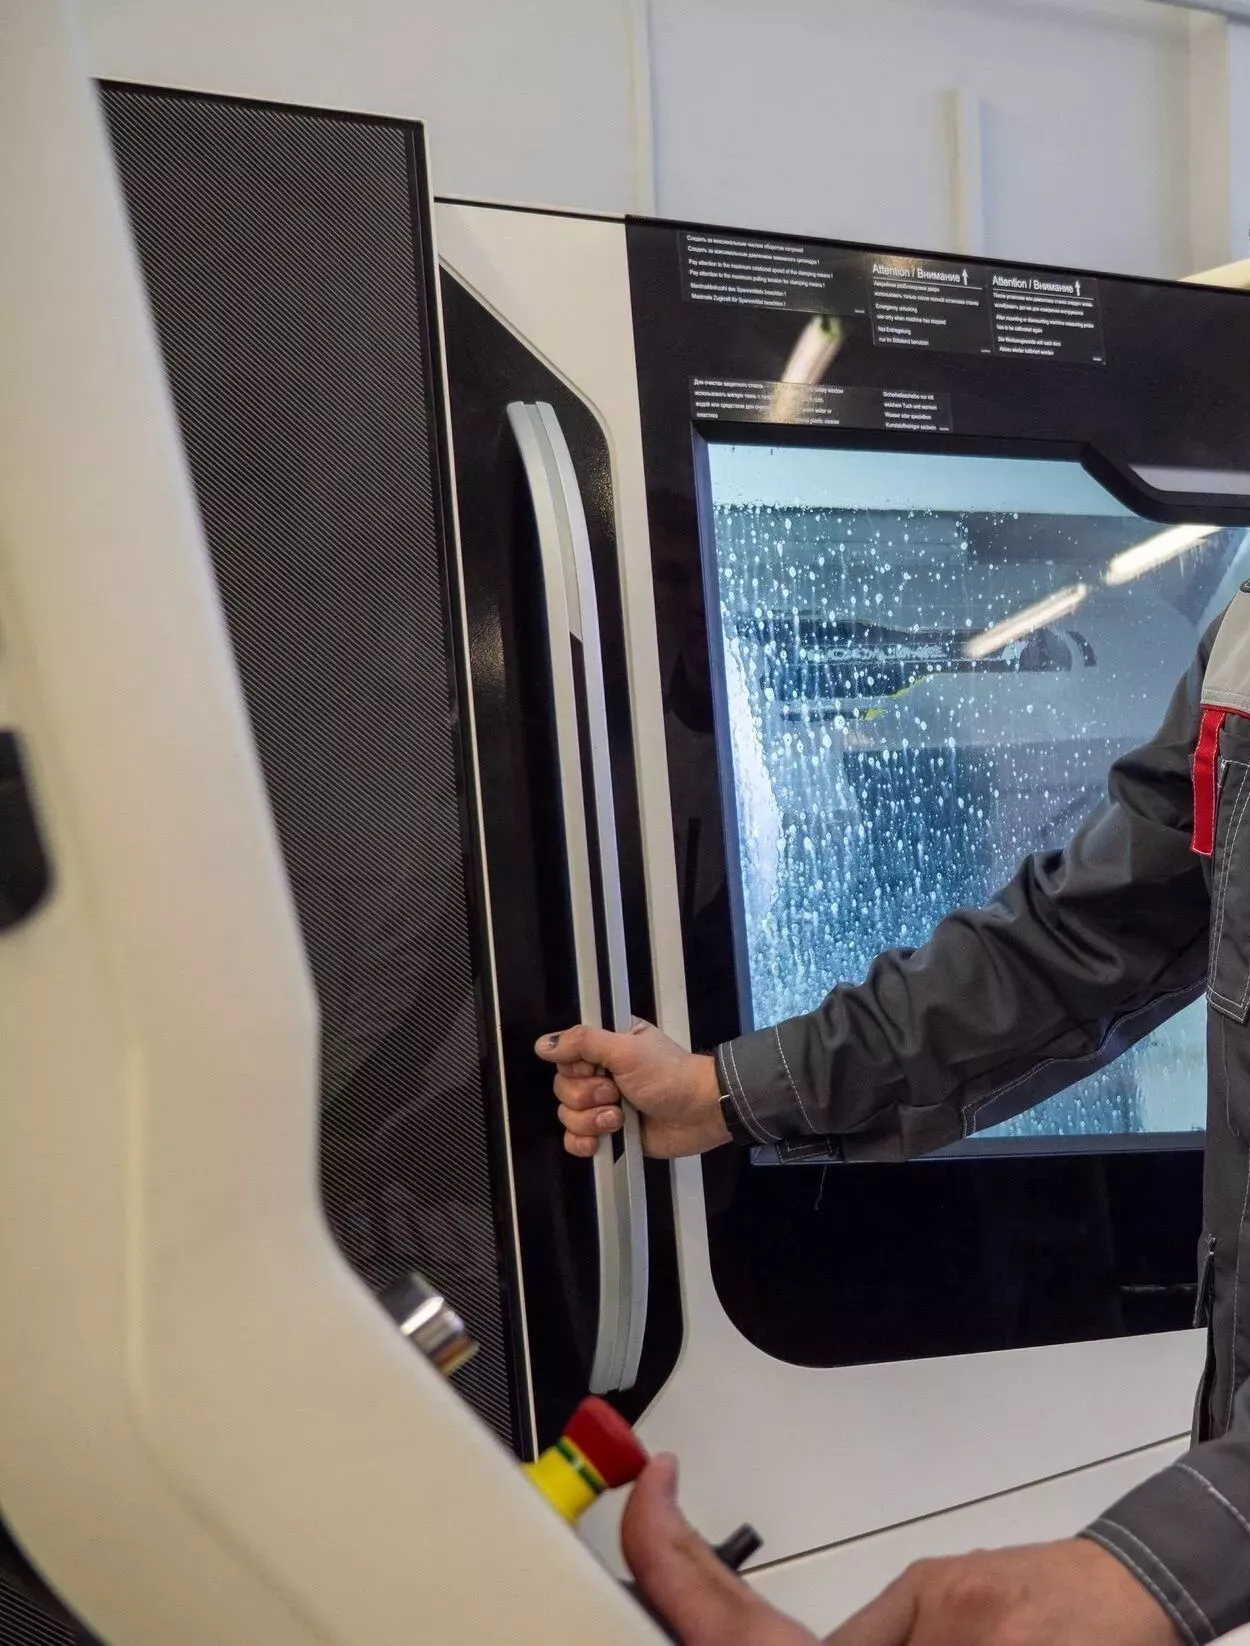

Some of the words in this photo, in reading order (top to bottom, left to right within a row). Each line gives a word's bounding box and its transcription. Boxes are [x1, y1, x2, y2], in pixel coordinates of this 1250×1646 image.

[873, 264, 910, 277] Attention
[917, 268, 960, 282] Внимание
[993, 276, 1027, 288] Attention
[1034, 280, 1073, 293] Внимание
